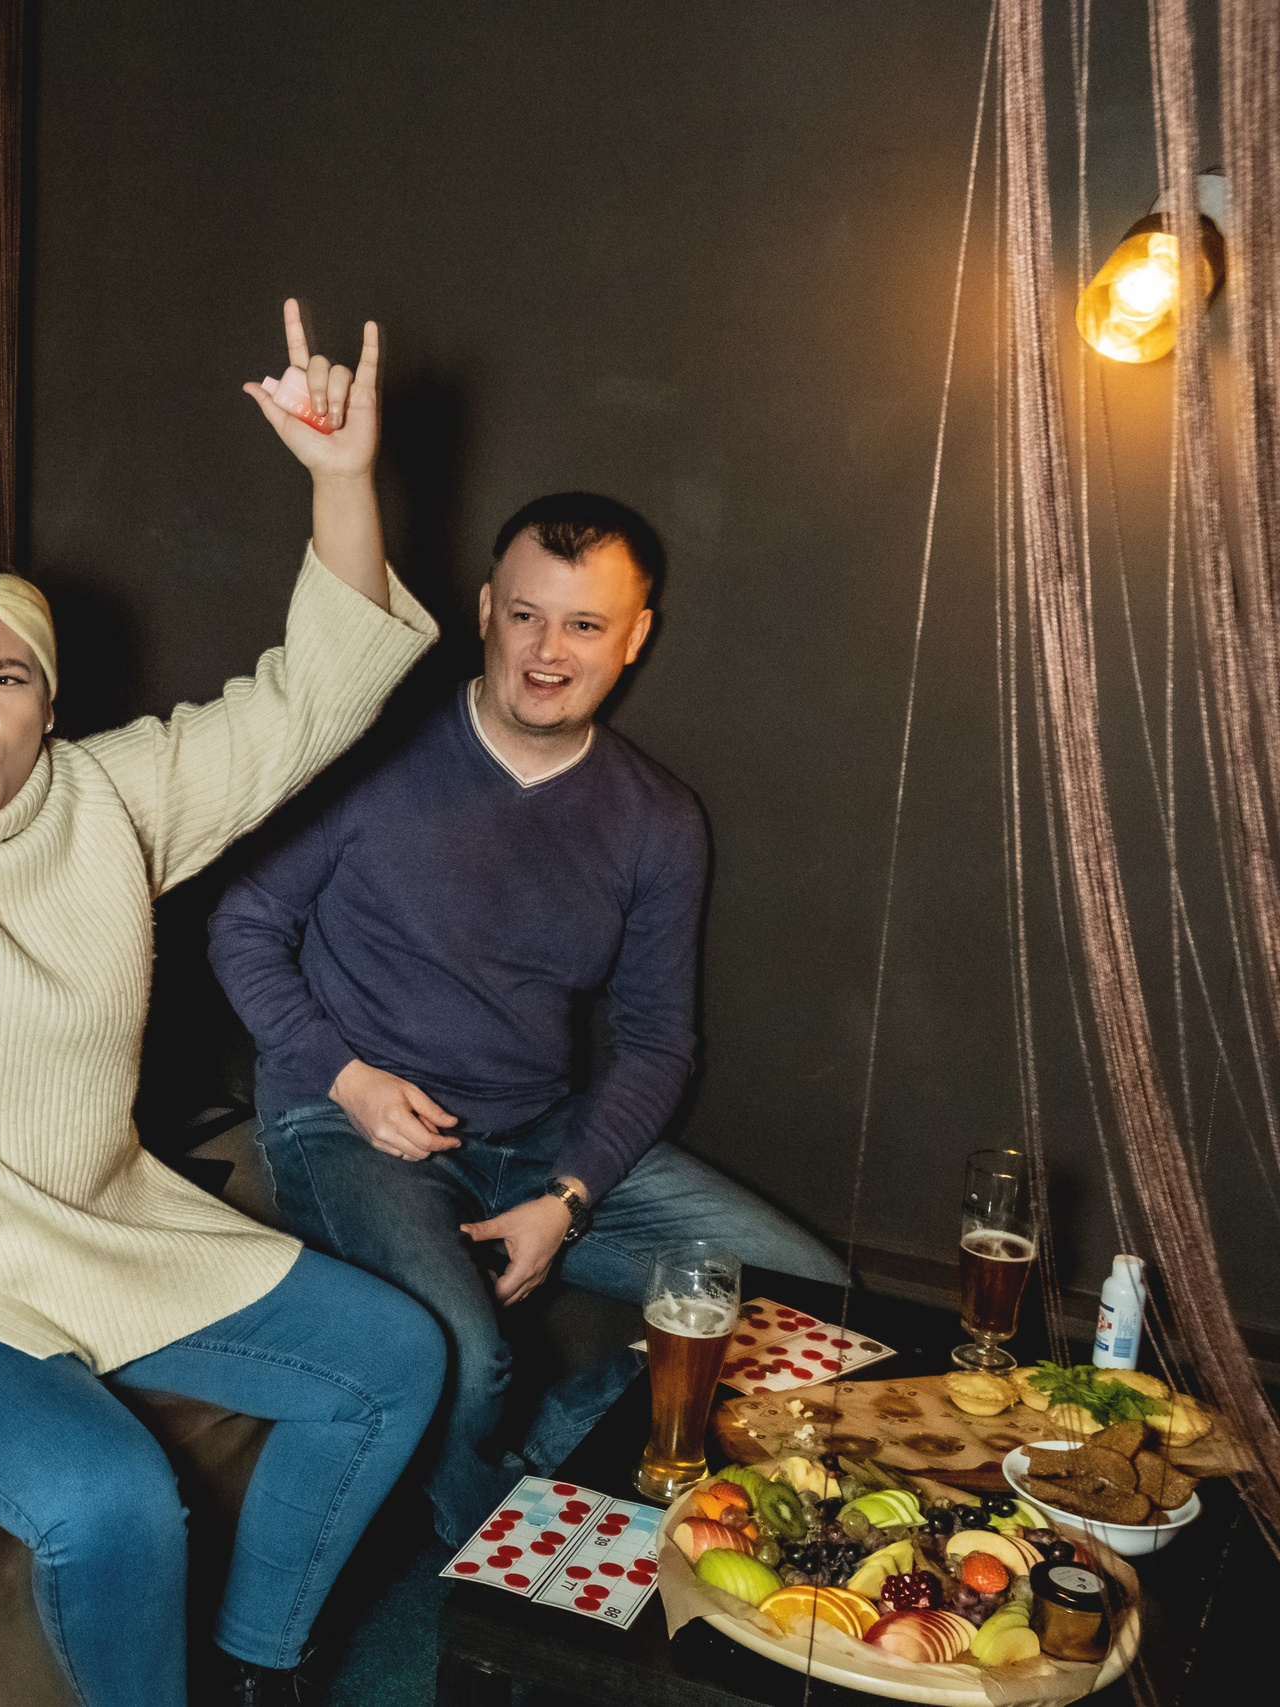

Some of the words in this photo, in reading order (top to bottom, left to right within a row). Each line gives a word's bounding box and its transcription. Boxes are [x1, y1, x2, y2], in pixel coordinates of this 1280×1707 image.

[594, 1536, 611, 1546] 39
[561, 1580, 578, 1591] 77
[604, 1606, 621, 1619] 88
